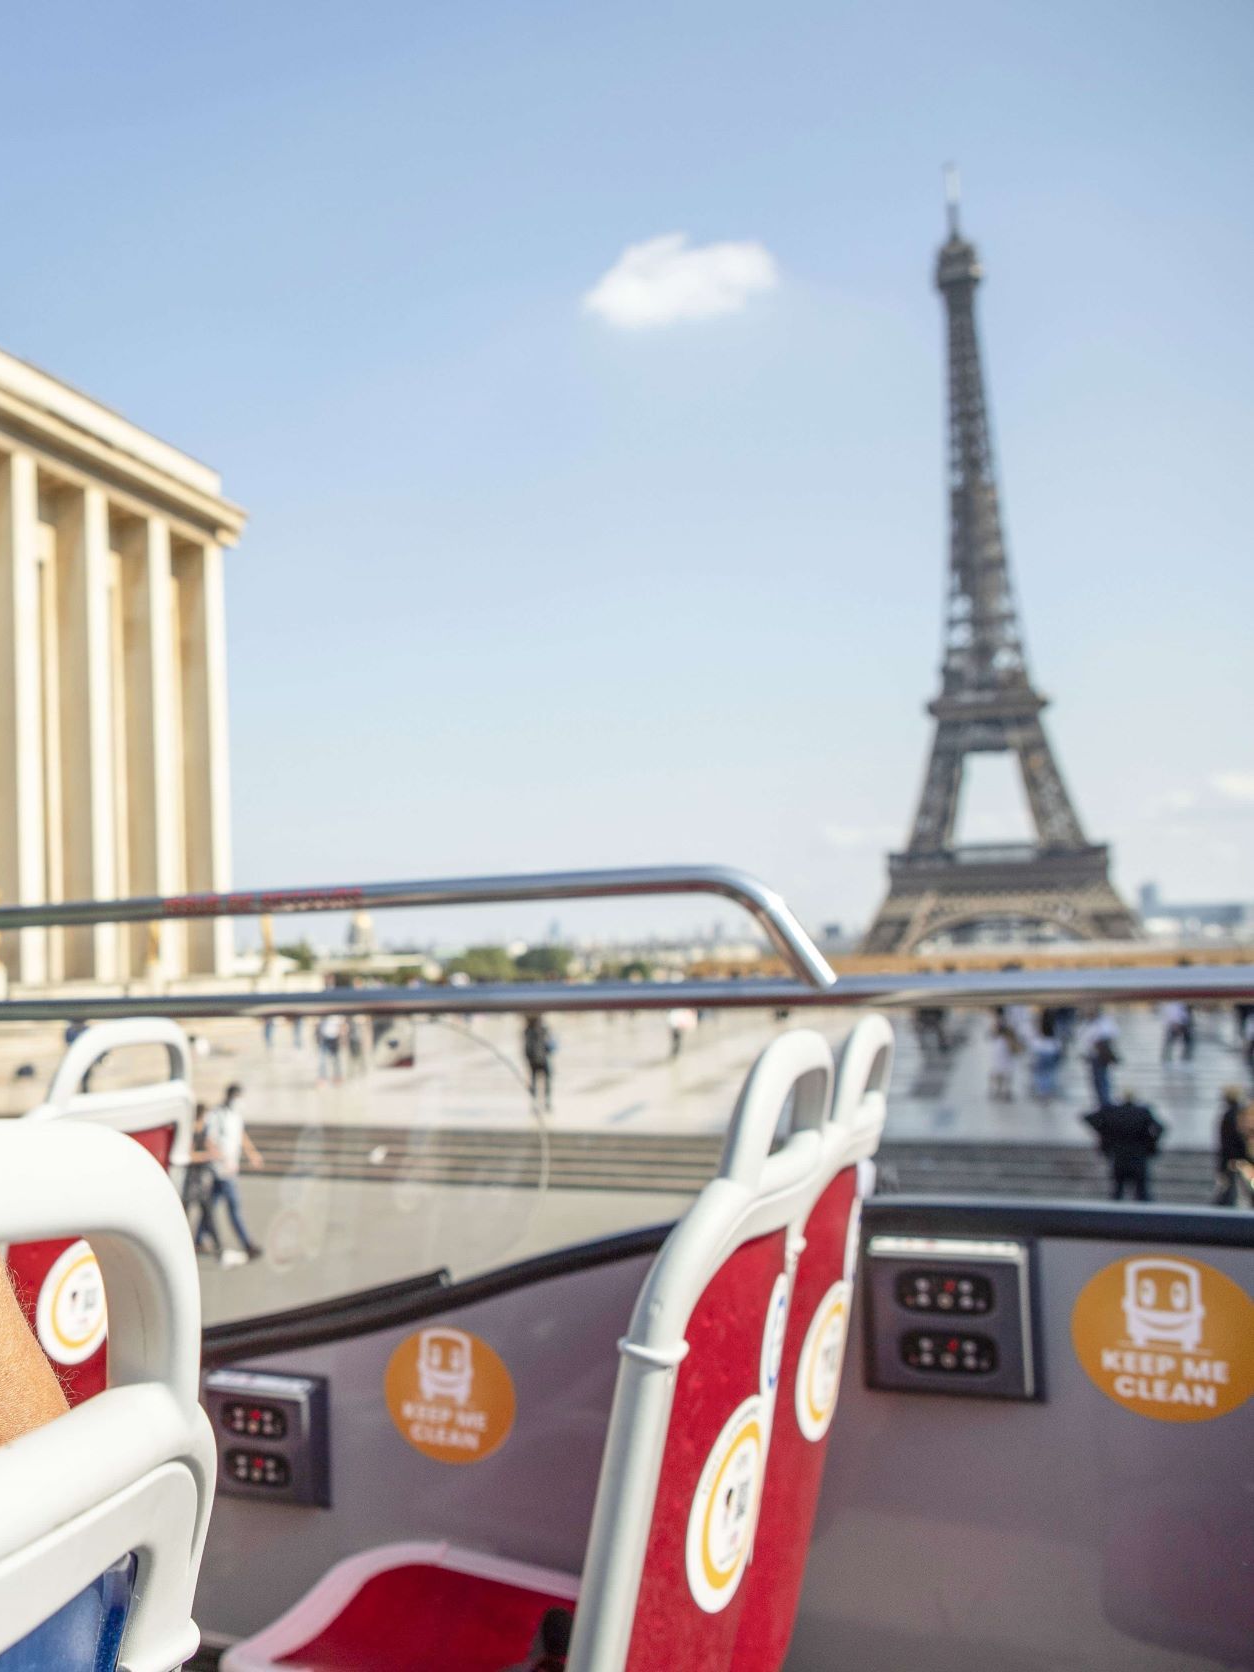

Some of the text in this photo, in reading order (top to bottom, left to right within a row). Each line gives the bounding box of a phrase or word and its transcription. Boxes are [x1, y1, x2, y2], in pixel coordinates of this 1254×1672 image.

[1102, 1349, 1229, 1384] KEEP ME
[1115, 1376, 1217, 1407] CLEAN
